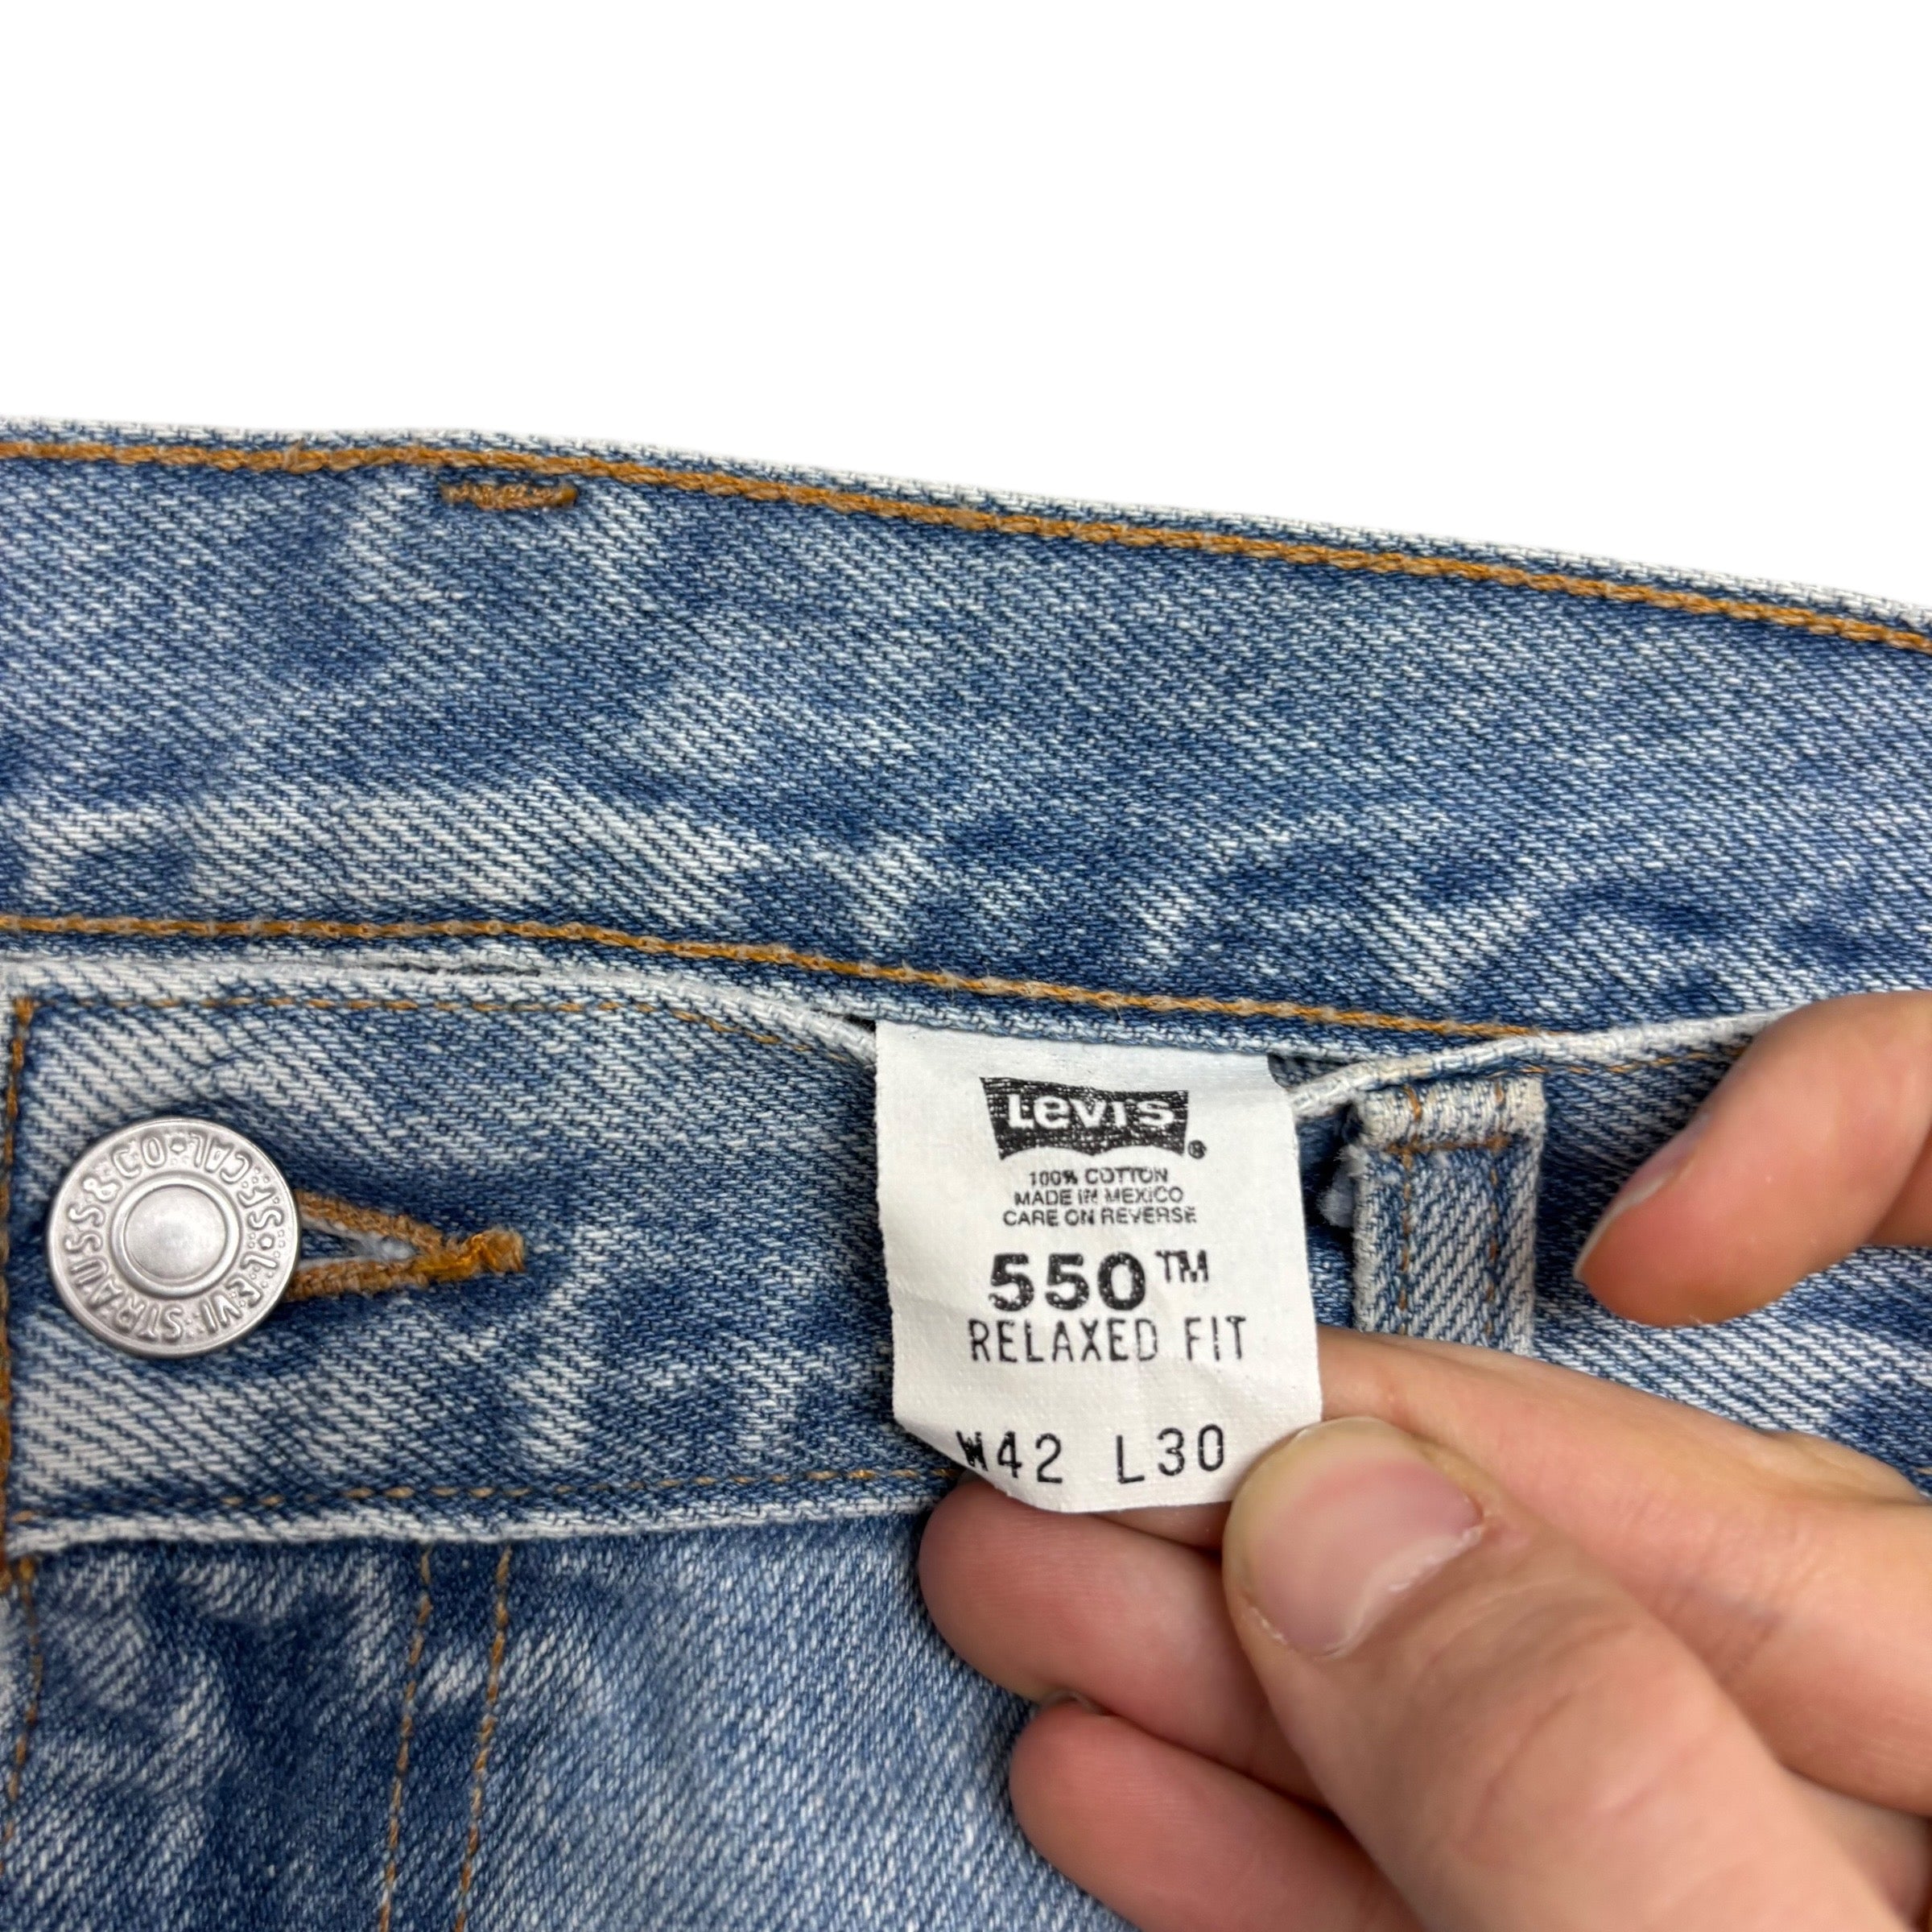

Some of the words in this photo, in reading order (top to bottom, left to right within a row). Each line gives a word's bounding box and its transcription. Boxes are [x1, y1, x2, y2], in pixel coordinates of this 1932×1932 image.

[82, 1175, 122, 1203] &
[1029, 1170, 1078, 1186] 100%
[1085, 1167, 1168, 1184] COTTON
[1014, 1189, 1072, 1206] MADE
[1078, 1188, 1097, 1205] IN
[1104, 1187, 1183, 1204] MEXICO
[1003, 1210, 1058, 1228] CARE
[1064, 1209, 1095, 1226] ON
[1101, 1207, 1197, 1224] REVERSE
[64, 1203, 184, 1344] STRAUSS
[202, 1253, 279, 1334] LEVI
[968, 1318, 1158, 1362] RELAXED
[1185, 1316, 1246, 1361] FIT
[956, 1430, 1063, 1484] W42
[1116, 1424, 1224, 1484] L30
